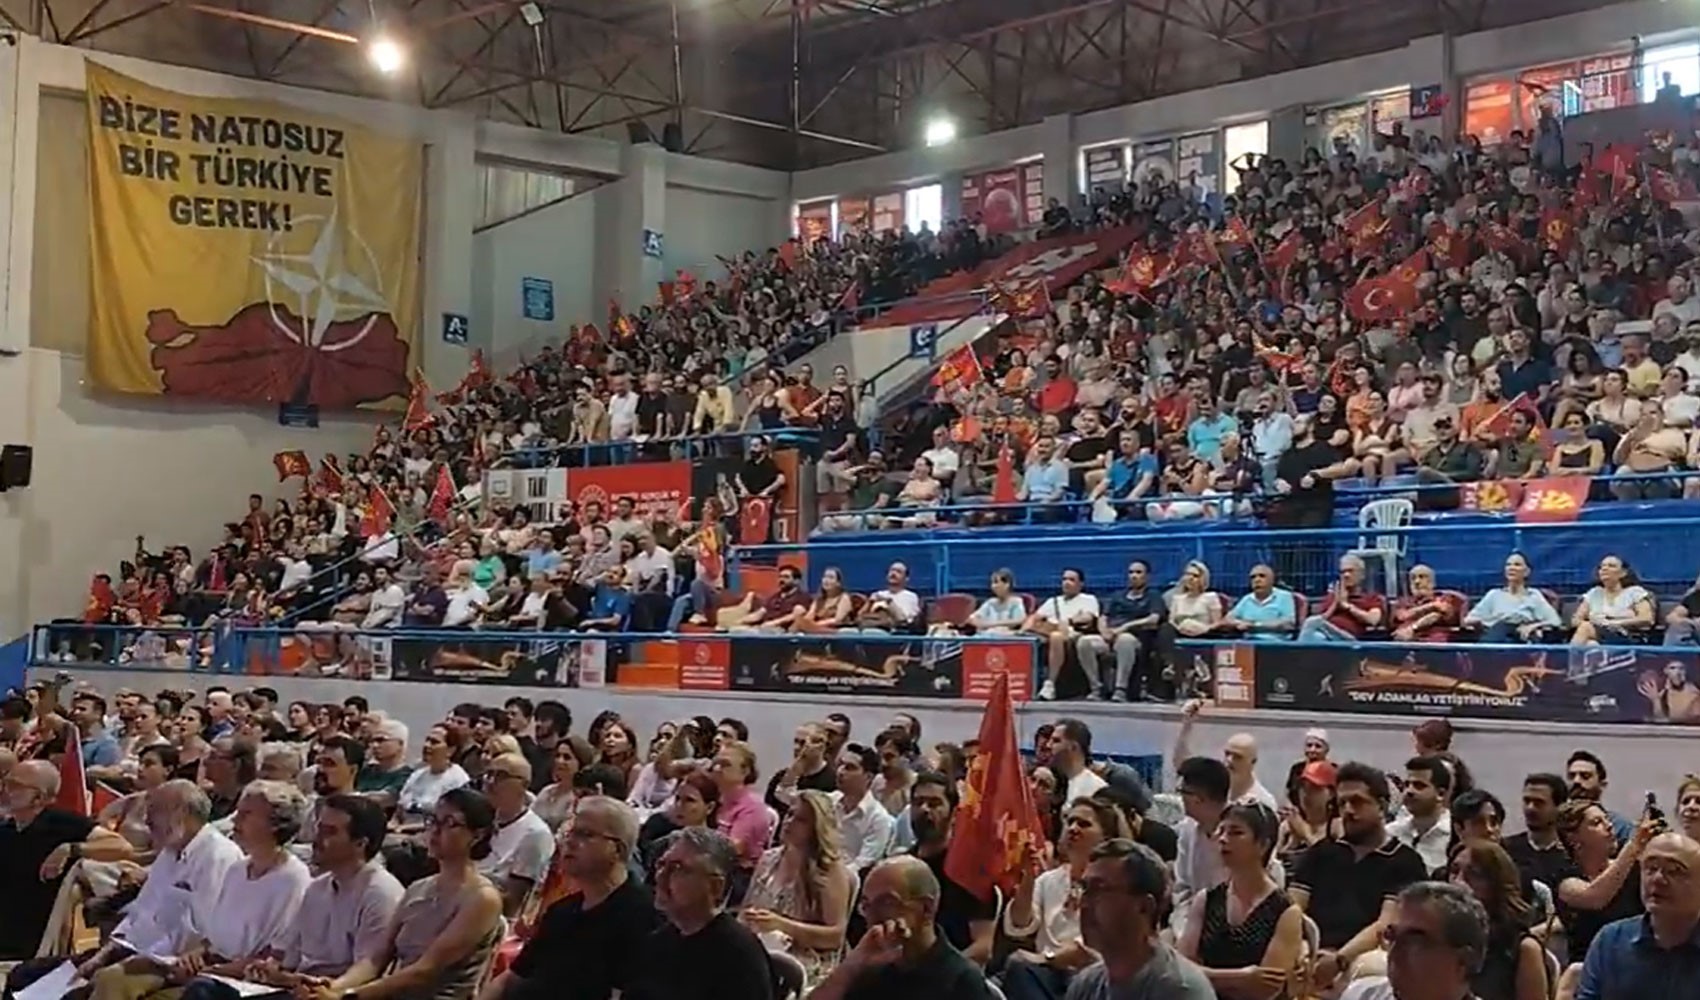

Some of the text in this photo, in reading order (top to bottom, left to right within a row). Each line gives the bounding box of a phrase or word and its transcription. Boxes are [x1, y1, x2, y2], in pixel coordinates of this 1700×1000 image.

[99, 94, 345, 159] BİZE NATOSUZ
[118, 139, 333, 197] BİR TÜRKİYE
[168, 195, 293, 232] GEREK!
